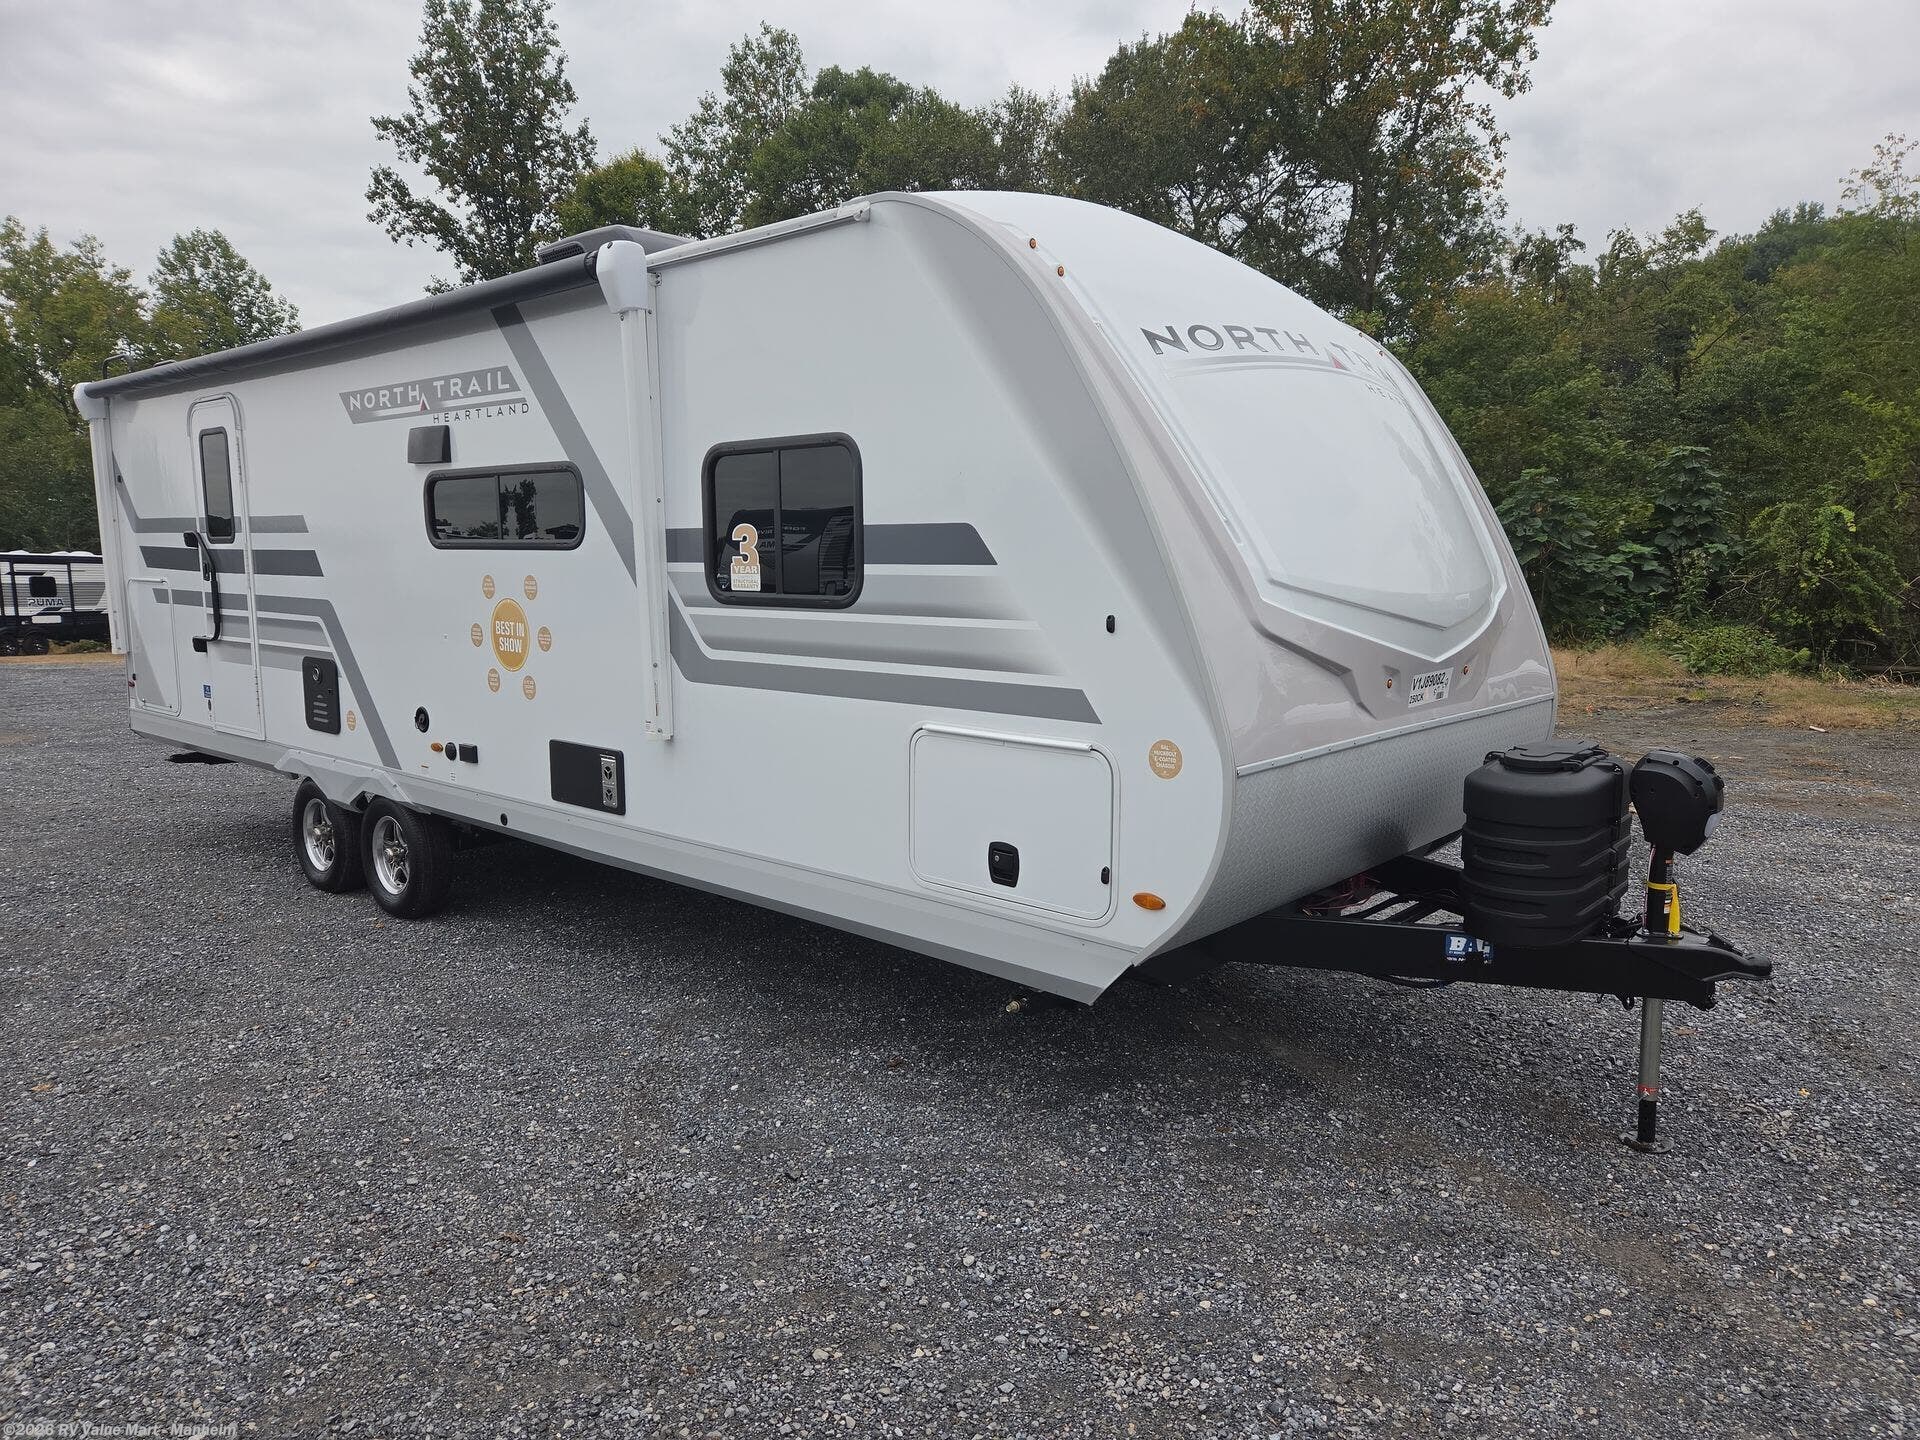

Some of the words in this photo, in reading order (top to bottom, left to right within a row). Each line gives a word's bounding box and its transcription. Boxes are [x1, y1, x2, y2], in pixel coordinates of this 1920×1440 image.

[1140, 324, 1320, 355] NORTH
[350, 384, 420, 411] NORTH
[433, 371, 510, 398] TRAIL
[433, 403, 530, 424] HEARTLAND
[731, 523, 760, 566] 3
[733, 565, 758, 574] YEAR
[28, 598, 64, 607] PUMA
[495, 620, 514, 636] BEST
[516, 622, 525, 637] IN
[499, 637, 523, 653] SHOW
